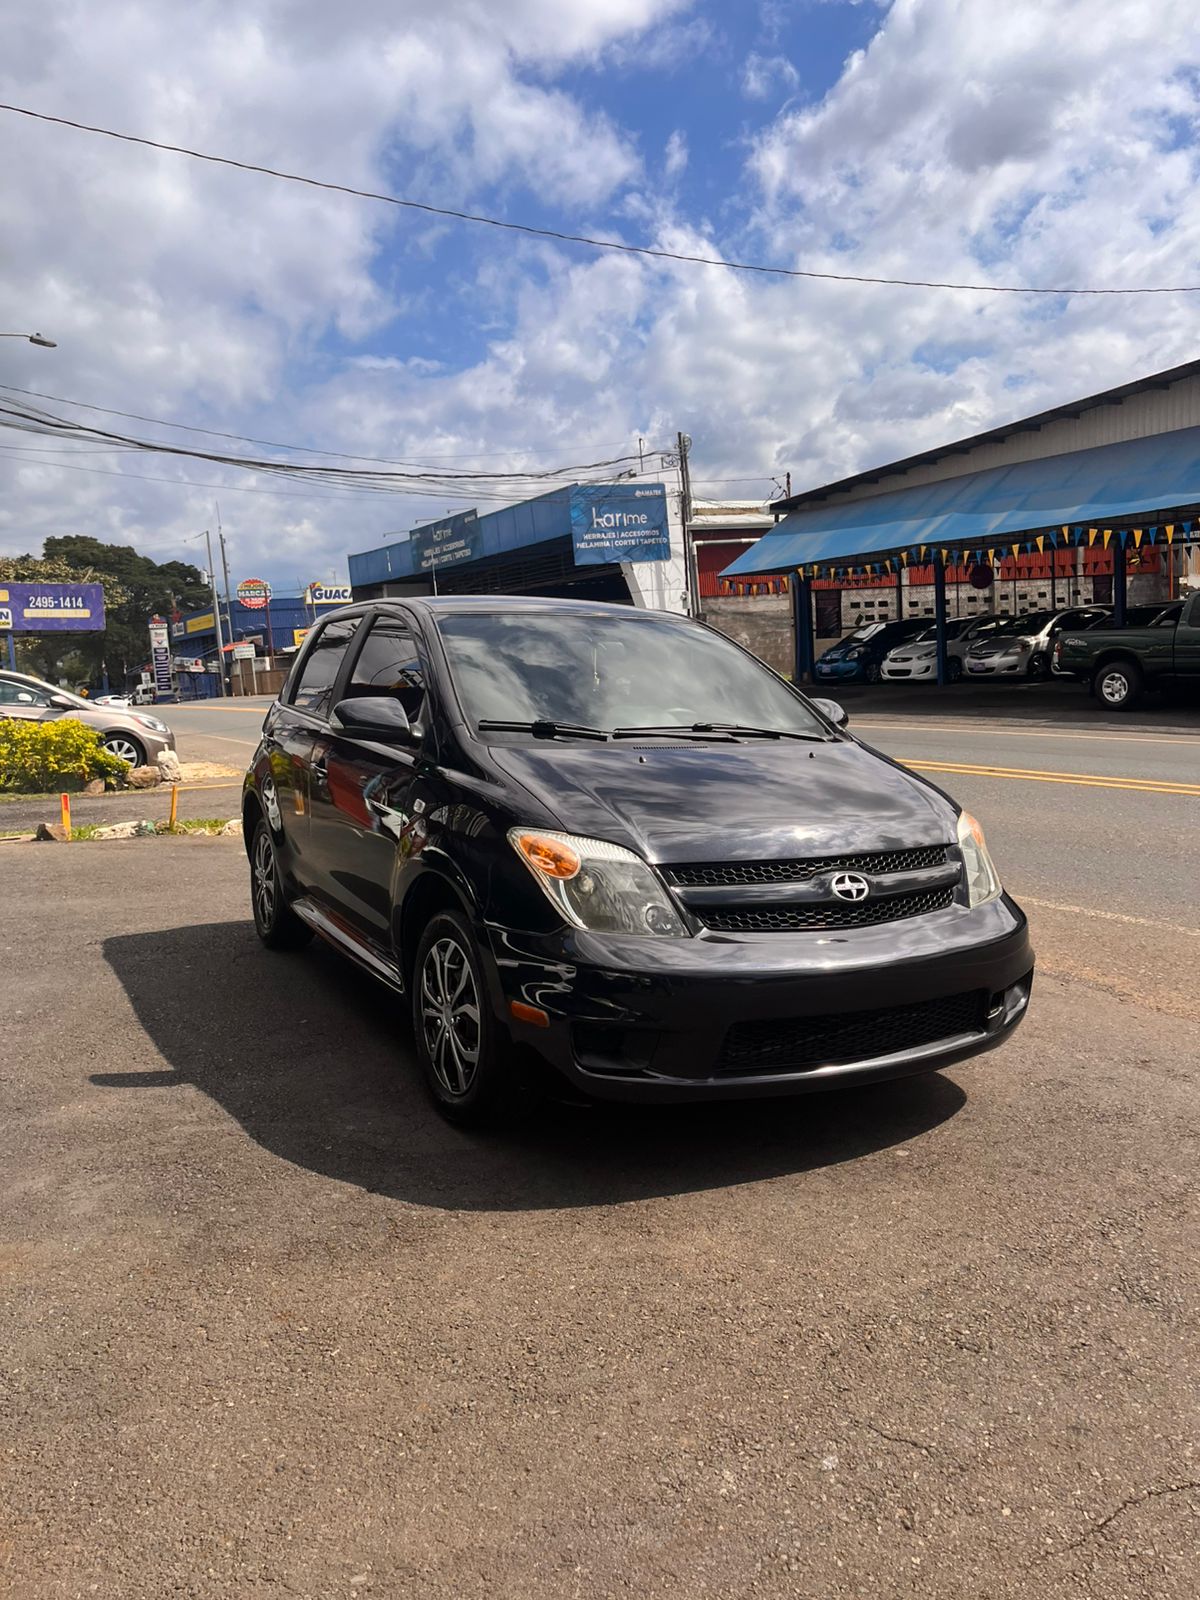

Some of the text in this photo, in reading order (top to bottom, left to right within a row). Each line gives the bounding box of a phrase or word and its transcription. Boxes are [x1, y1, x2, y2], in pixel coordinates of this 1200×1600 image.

[592, 506, 648, 528] karime
[583, 530, 660, 540] HERRAJES ACCESORIOS
[576, 541, 611, 549] MELAMINA
[640, 537, 668, 545] TAPETEO
[238, 589, 271, 597] MARCAS
[29, 596, 83, 608] 2495-1414
